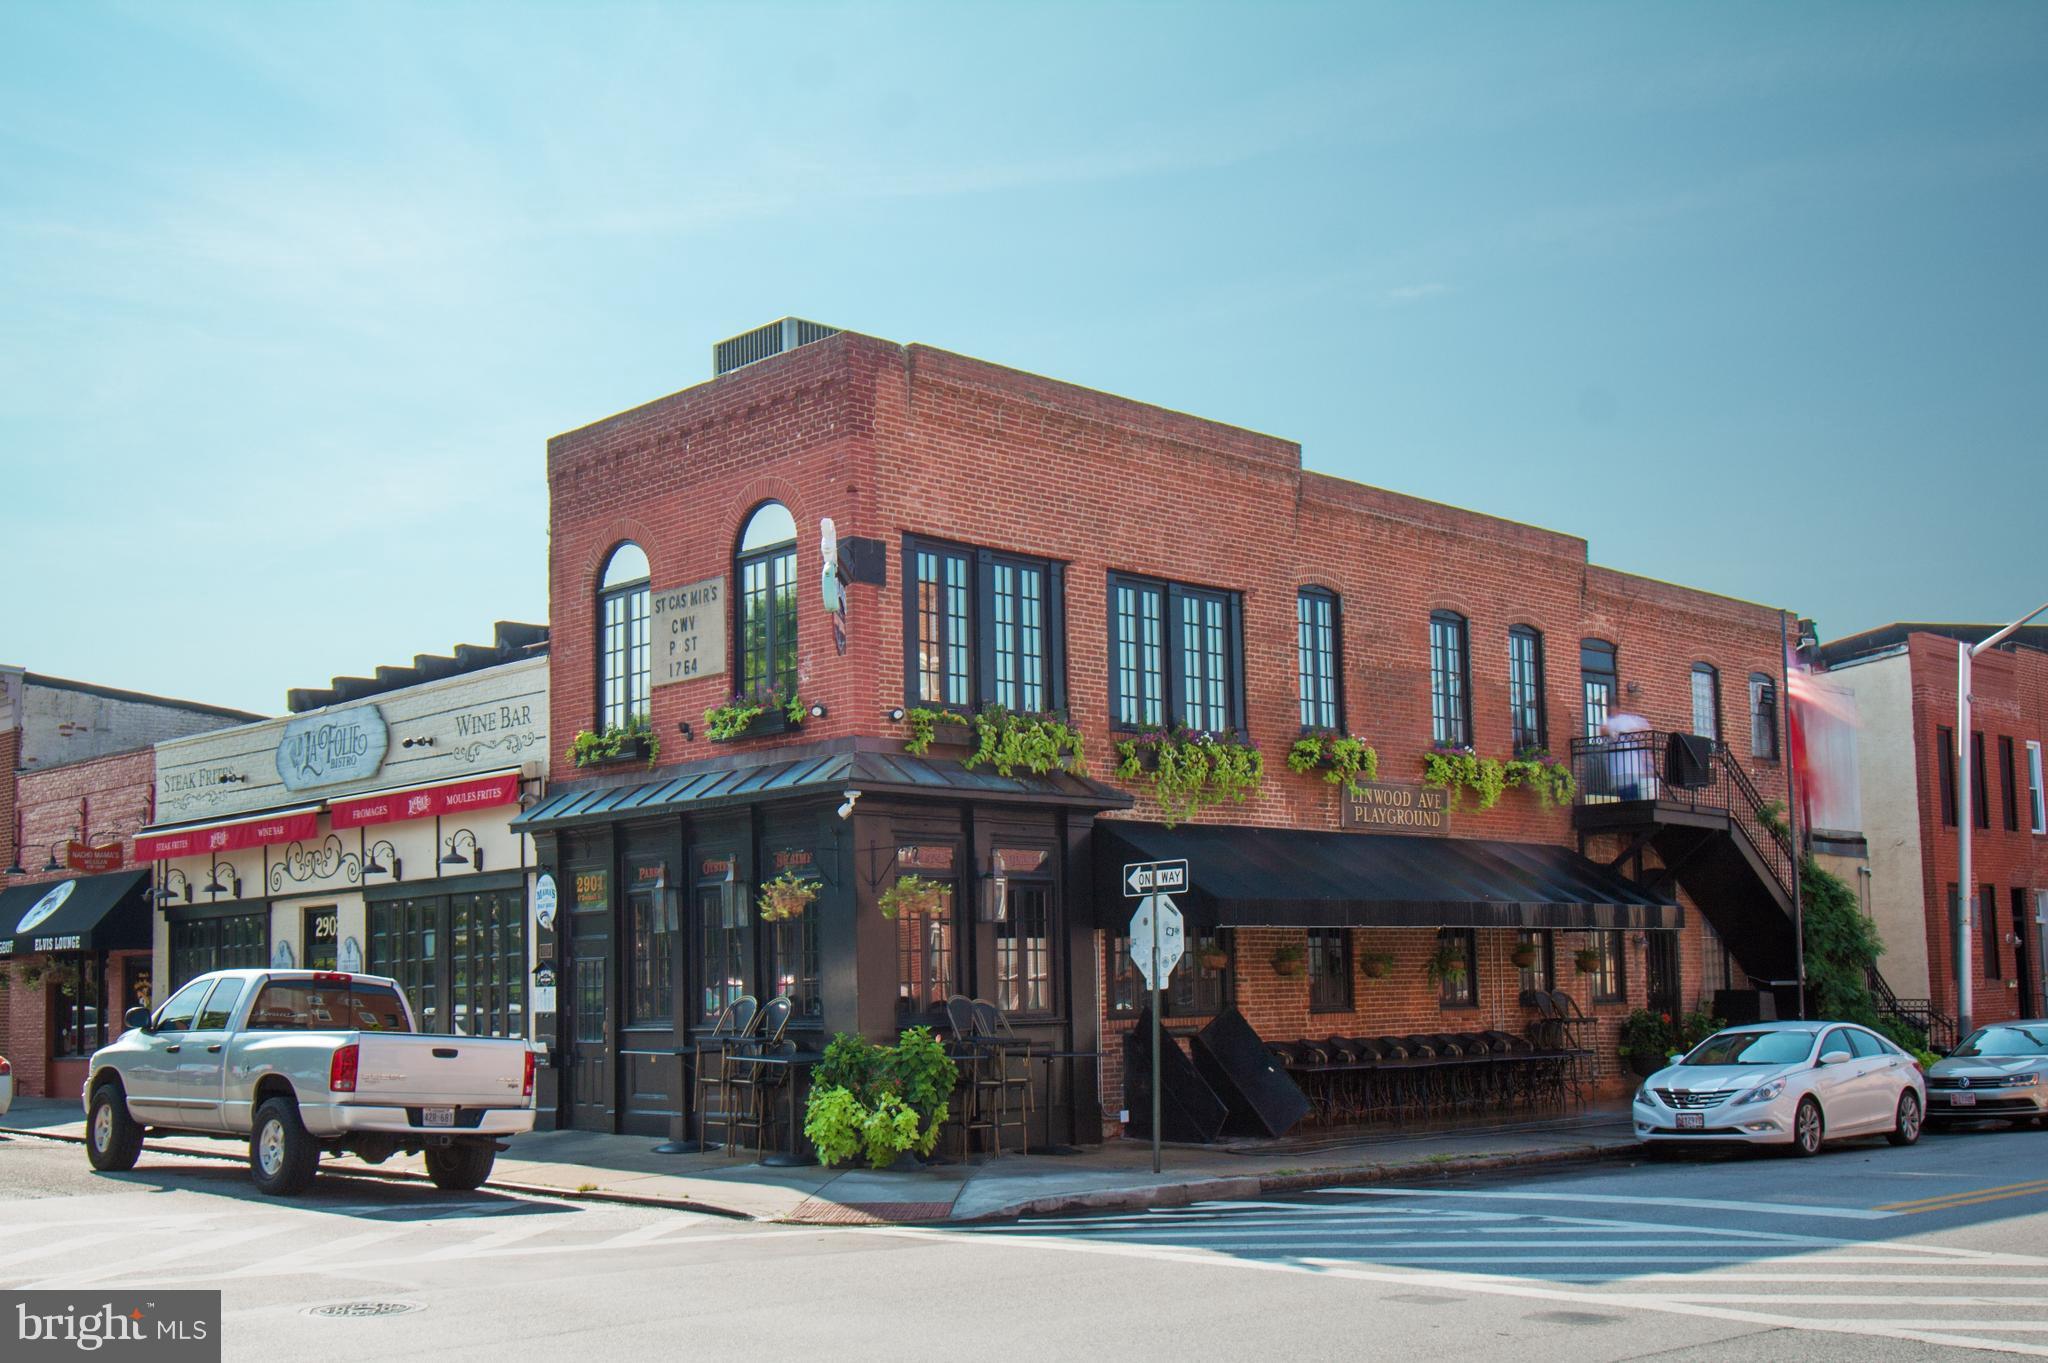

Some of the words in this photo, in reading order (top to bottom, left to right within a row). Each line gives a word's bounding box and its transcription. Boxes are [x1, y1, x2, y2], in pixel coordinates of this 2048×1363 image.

[655, 598, 666, 614] ST
[669, 585, 718, 610] CASMIR'S
[671, 615, 695, 634] CWV
[669, 658, 698, 678] 1764
[455, 711, 497, 737] WINE
[500, 705, 532, 729] BAR
[318, 723, 368, 764] FOLIE
[330, 754, 358, 769] BISTRO
[164, 772, 197, 793] STEAK
[352, 805, 389, 819] FROMAGES
[446, 791, 477, 806] MOULES
[477, 788, 502, 800] FRITES
[1350, 788, 1412, 807] LINWOOD
[1417, 792, 1441, 809] AVE
[1354, 806, 1441, 827] PLAYGROUND
[576, 875, 604, 893] 2901
[1138, 873, 1154, 886] ON
[1161, 871, 1181, 884] WAY
[315, 915, 338, 937] 290
[34, 938, 53, 951] ELVIS
[54, 935, 80, 950] LOUNGE
